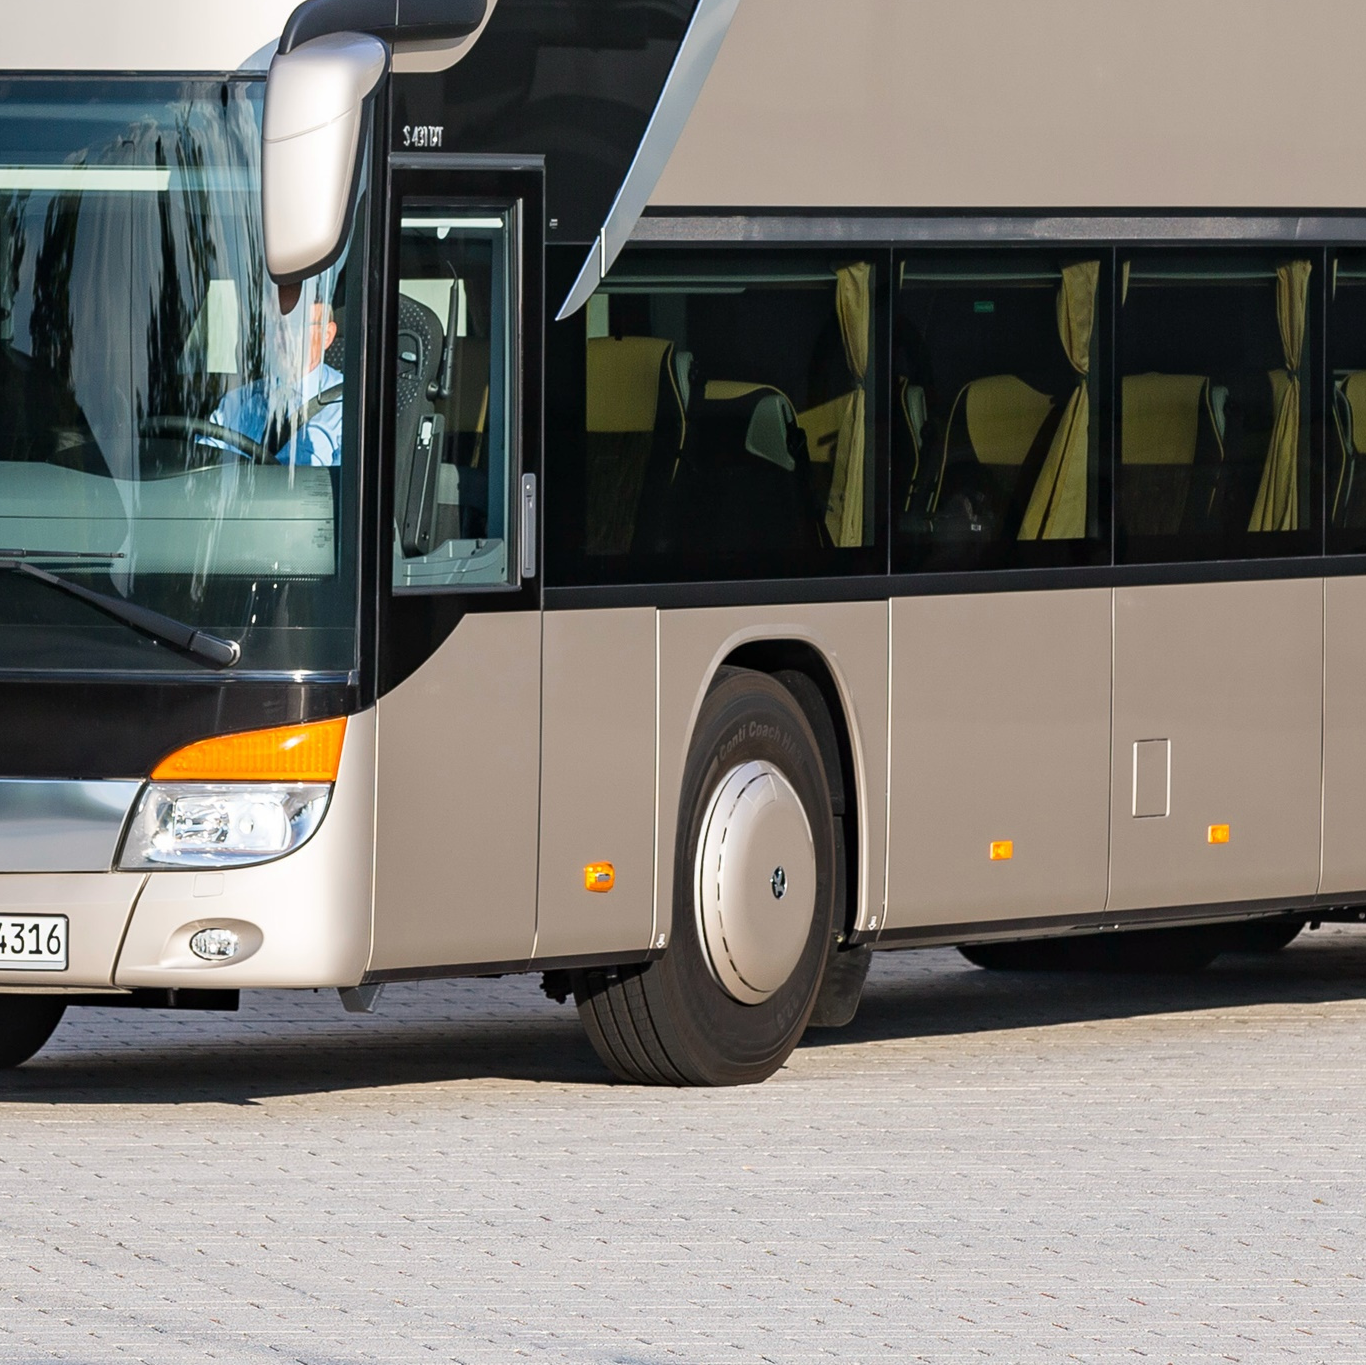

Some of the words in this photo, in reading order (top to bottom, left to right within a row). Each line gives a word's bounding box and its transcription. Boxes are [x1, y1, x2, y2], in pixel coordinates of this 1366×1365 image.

[403, 125, 410, 147] S
[412, 125, 428, 147] 431
[719, 724, 746, 762] Conti
[748, 720, 782, 743] Coach
